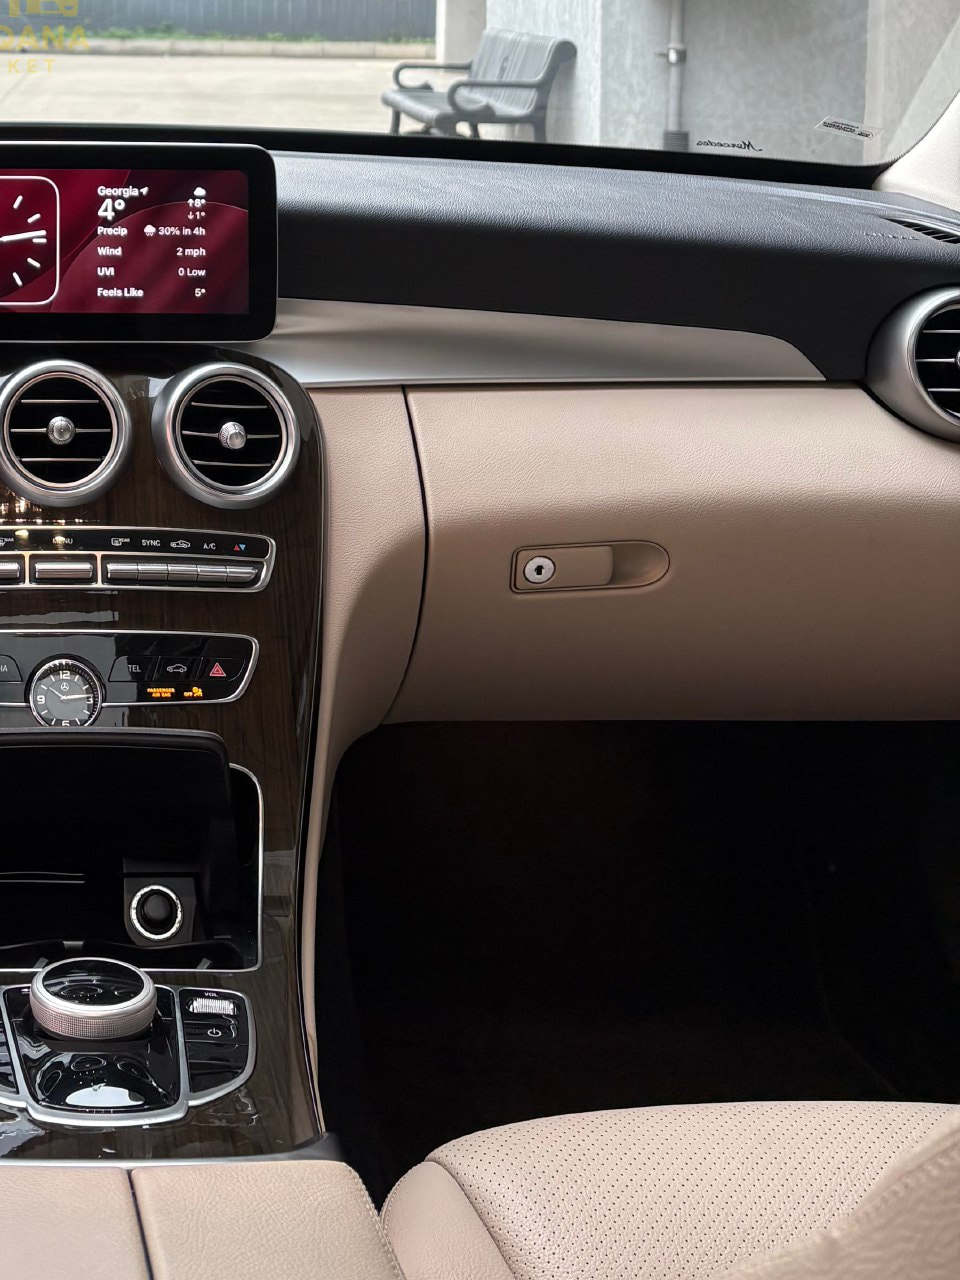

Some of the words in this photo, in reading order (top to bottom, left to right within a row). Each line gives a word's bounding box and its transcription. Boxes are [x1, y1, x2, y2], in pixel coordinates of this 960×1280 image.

[97, 185, 139, 198] Georgia
[97, 225, 128, 237] Precip
[158, 226, 180, 236] 30%
[182, 226, 191, 235] in
[193, 226, 206, 236] 4h
[97, 246, 122, 256] Wind
[176, 247, 183, 256] 2
[185, 247, 206, 258] mph
[97, 266, 115, 276] UVI
[178, 267, 185, 276] 0
[187, 267, 206, 276] Low
[97, 287, 123, 297] Feels
[123, 287, 144, 297] Like
[141, 539, 161, 547] SYNC
[203, 542, 217, 550] A/C
[128, 664, 142, 672] TEL
[59, 670, 71, 680] 12
[36, 695, 46, 705] 9
